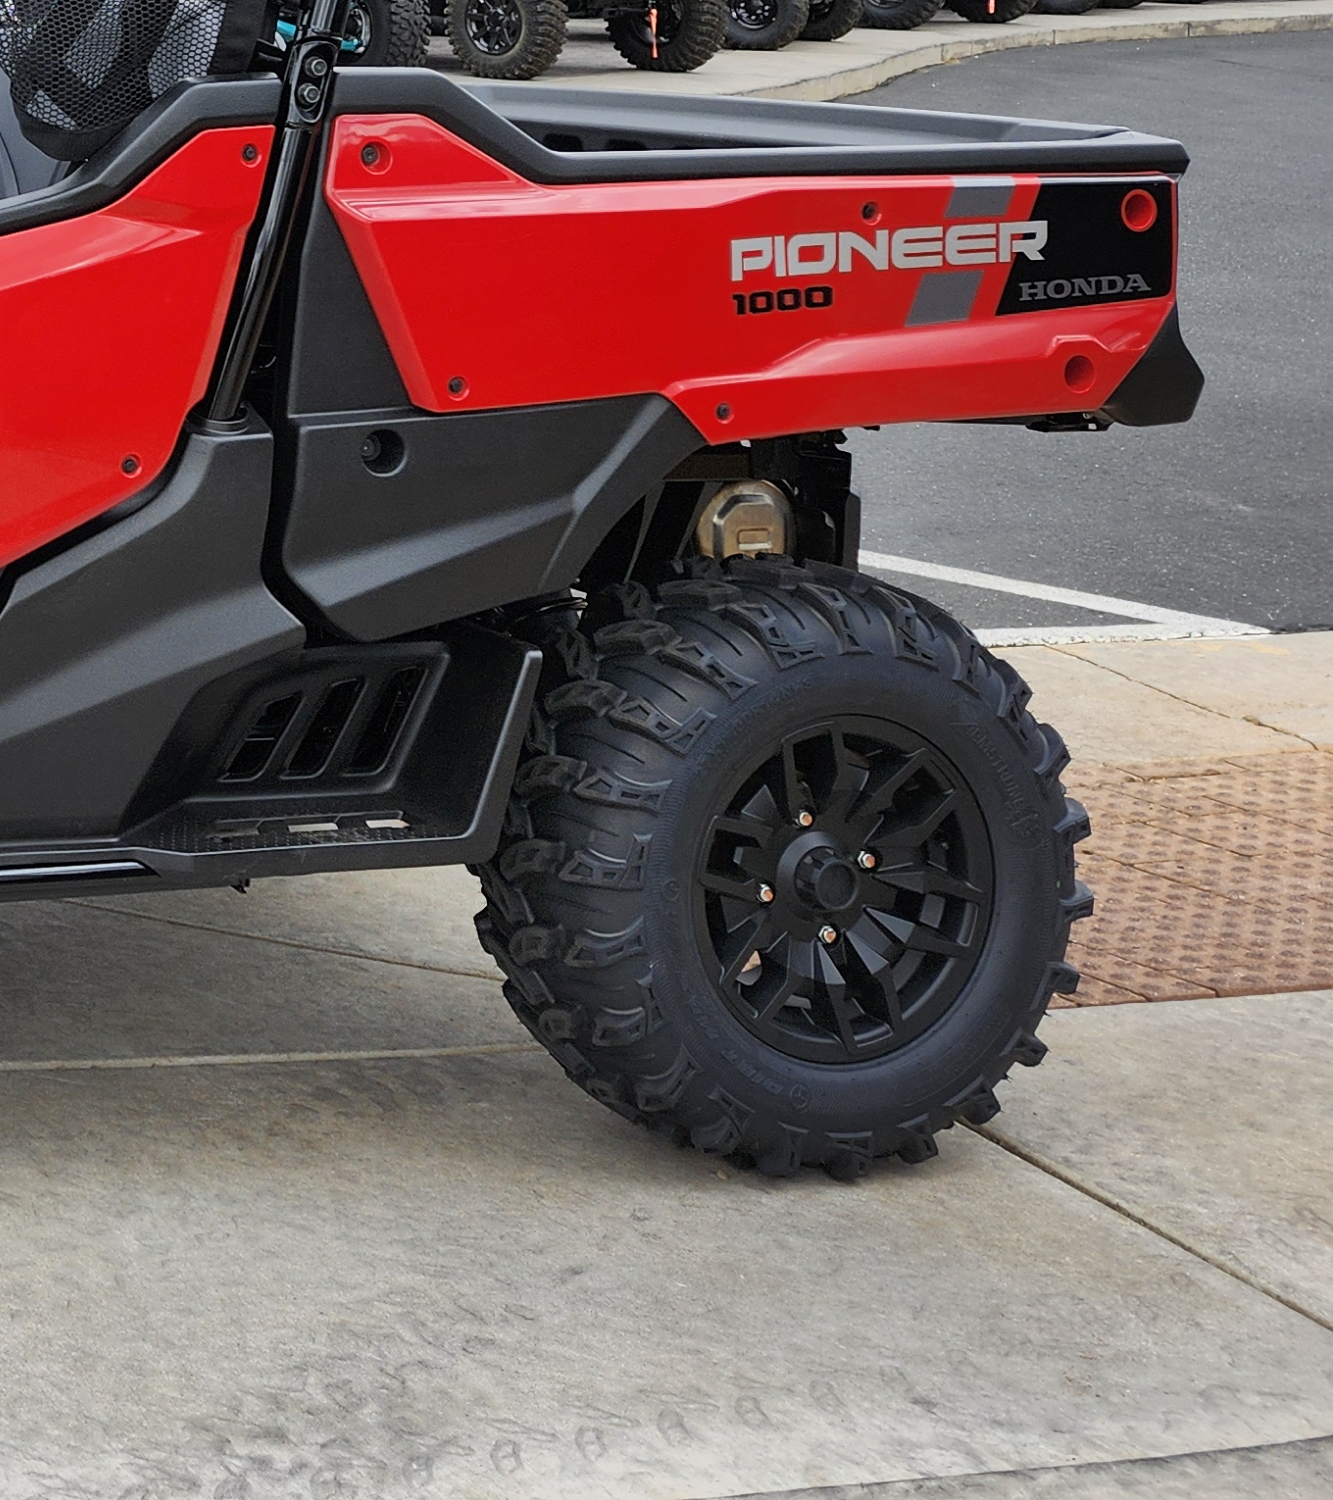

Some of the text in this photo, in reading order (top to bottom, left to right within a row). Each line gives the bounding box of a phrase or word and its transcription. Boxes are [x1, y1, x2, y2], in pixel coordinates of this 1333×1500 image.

[730, 220, 1049, 281] PIONEER
[731, 285, 834, 316] 1000
[1018, 273, 1152, 303] HONDA
